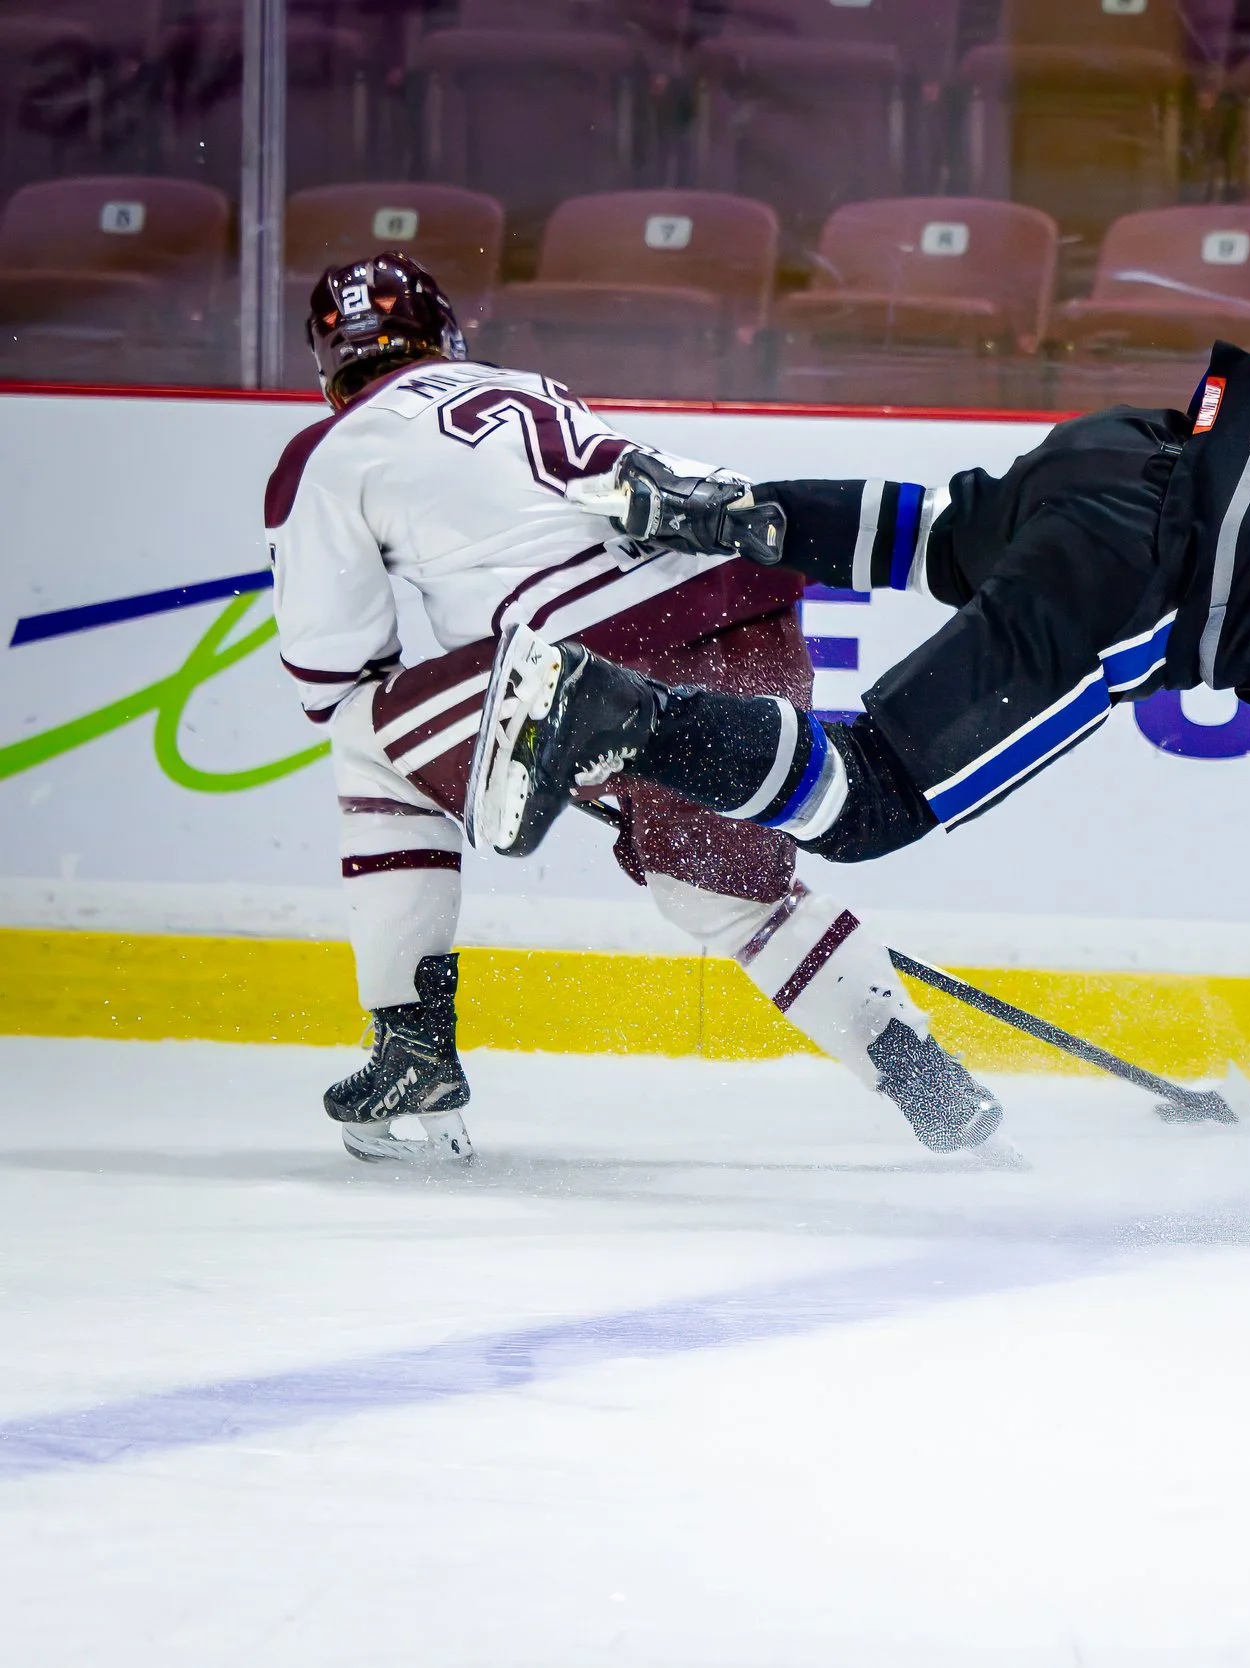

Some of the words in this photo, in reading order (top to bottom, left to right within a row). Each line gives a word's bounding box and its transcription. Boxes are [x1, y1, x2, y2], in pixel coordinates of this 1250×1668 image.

[661, 223, 676, 242] 7
[342, 283, 372, 315] 21
[370, 1066, 418, 1120] CCM
